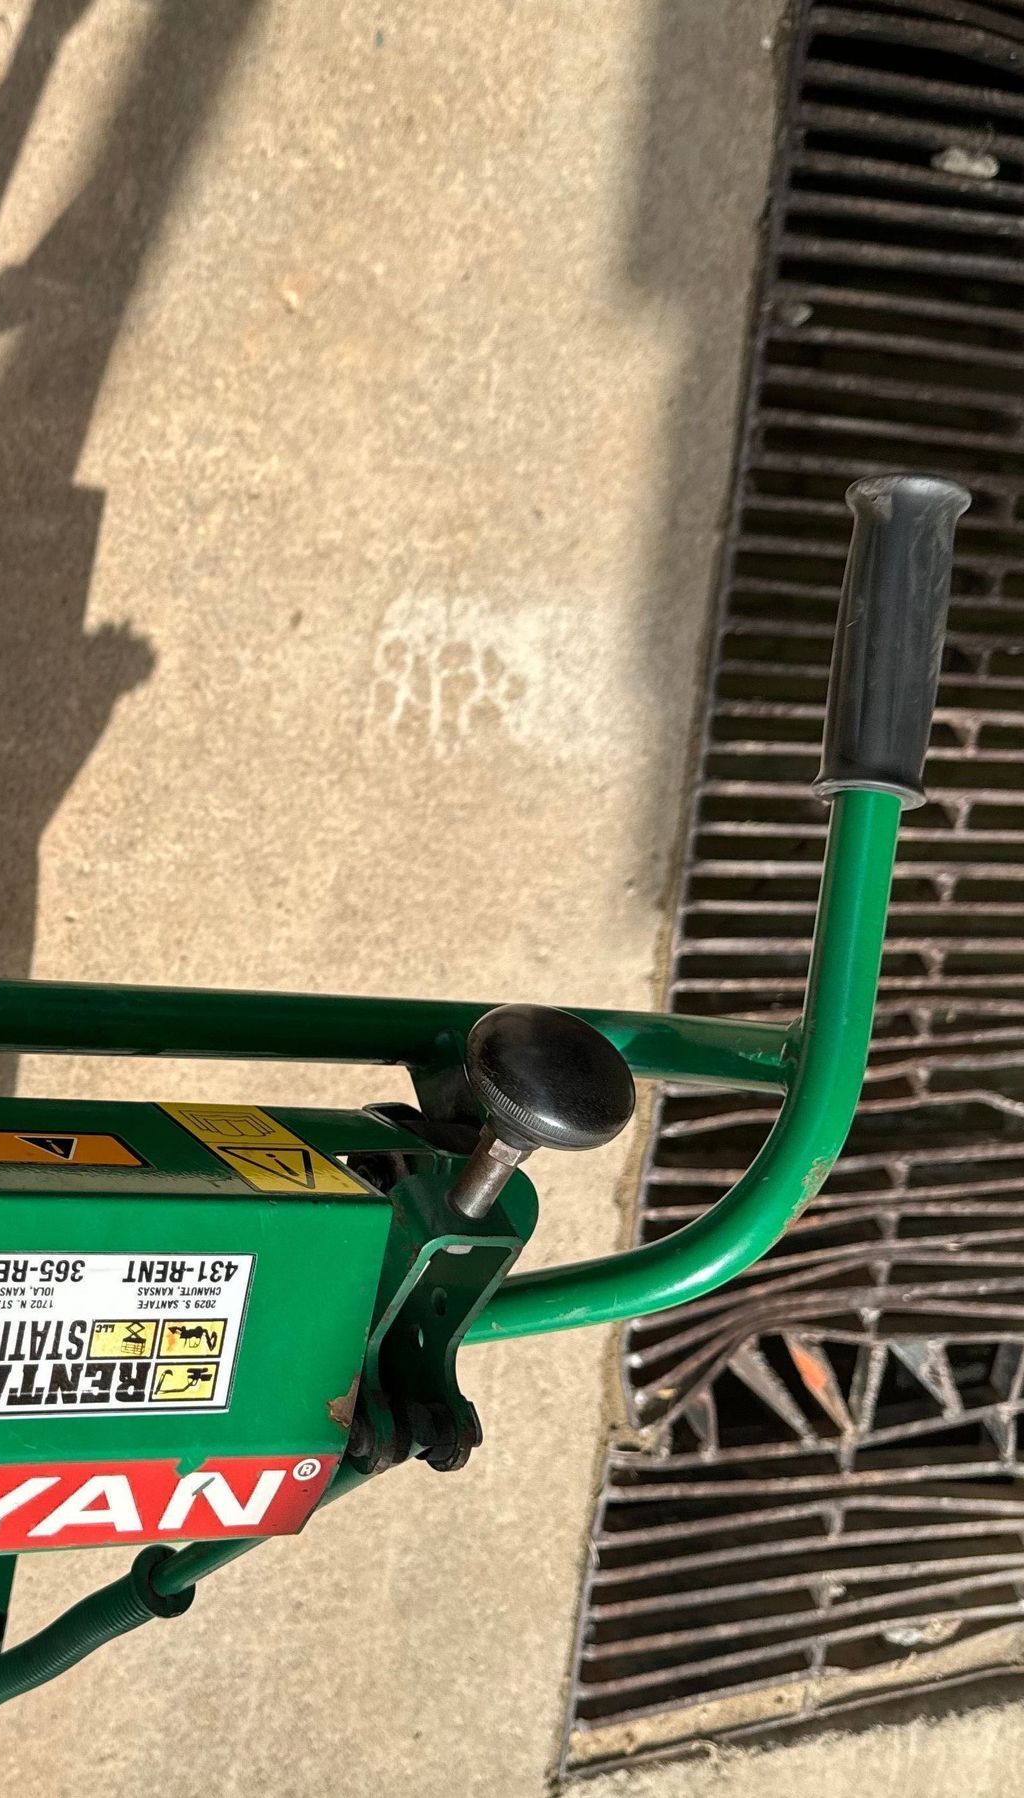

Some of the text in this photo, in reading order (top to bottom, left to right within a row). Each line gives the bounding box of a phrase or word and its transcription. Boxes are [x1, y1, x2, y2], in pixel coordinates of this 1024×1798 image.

[121, 1260, 239, 1283] 431-RENT
[29, 1285, 55, 1296] IOLA,
[137, 1285, 222, 1296] CHANUTE, KANSAS
[17, 1299, 27, 1309] N.
[30, 1299, 54, 1309] 1702
[137, 1299, 217, 1310] 2029 S. SANTAFE
[95, 1324, 115, 1334] LLC
